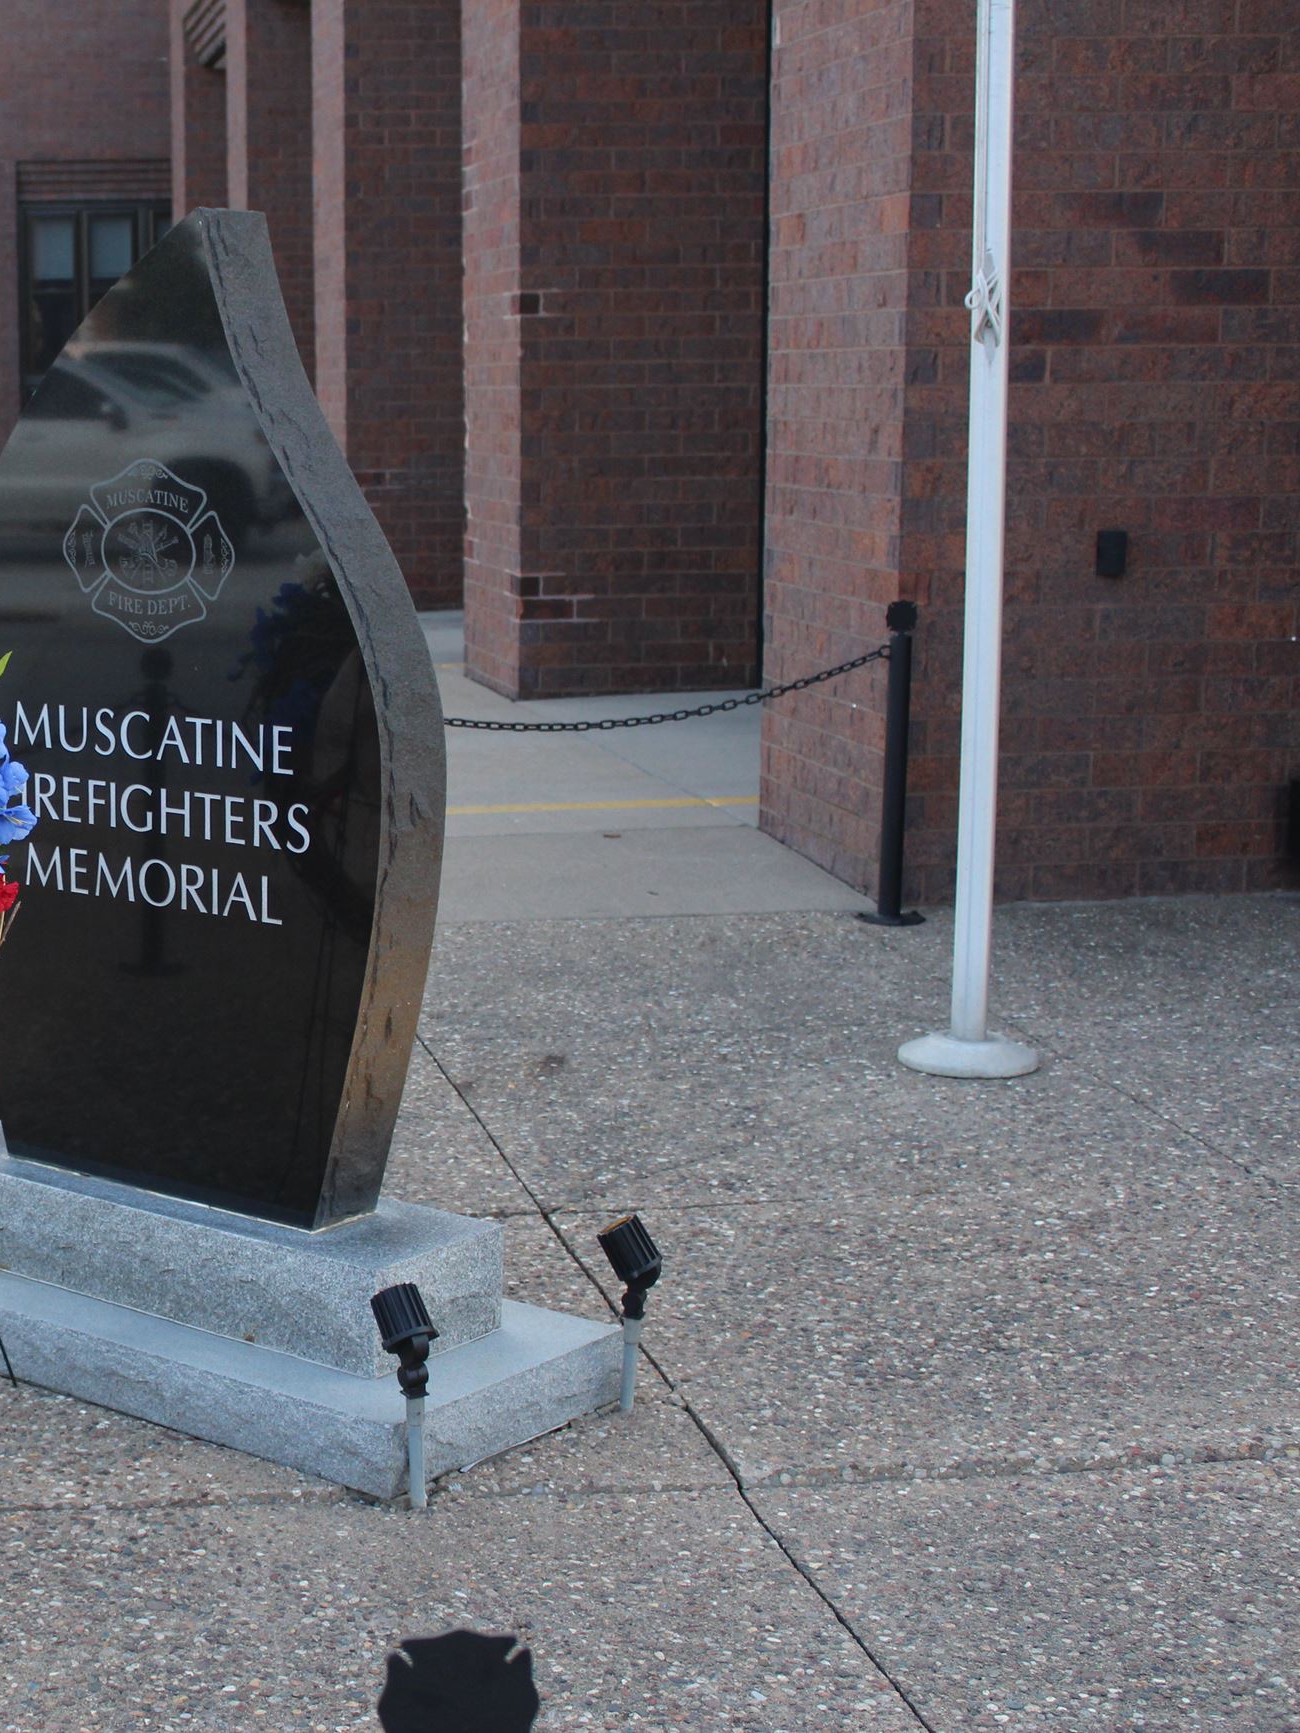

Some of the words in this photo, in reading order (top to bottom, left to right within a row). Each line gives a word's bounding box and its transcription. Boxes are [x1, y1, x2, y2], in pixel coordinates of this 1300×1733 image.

[106, 488, 190, 514] MUSCATINE
[107, 591, 144, 615] FIRE
[13, 700, 294, 776] MUSCATINE
[25, 842, 283, 926] MEMORIAL
